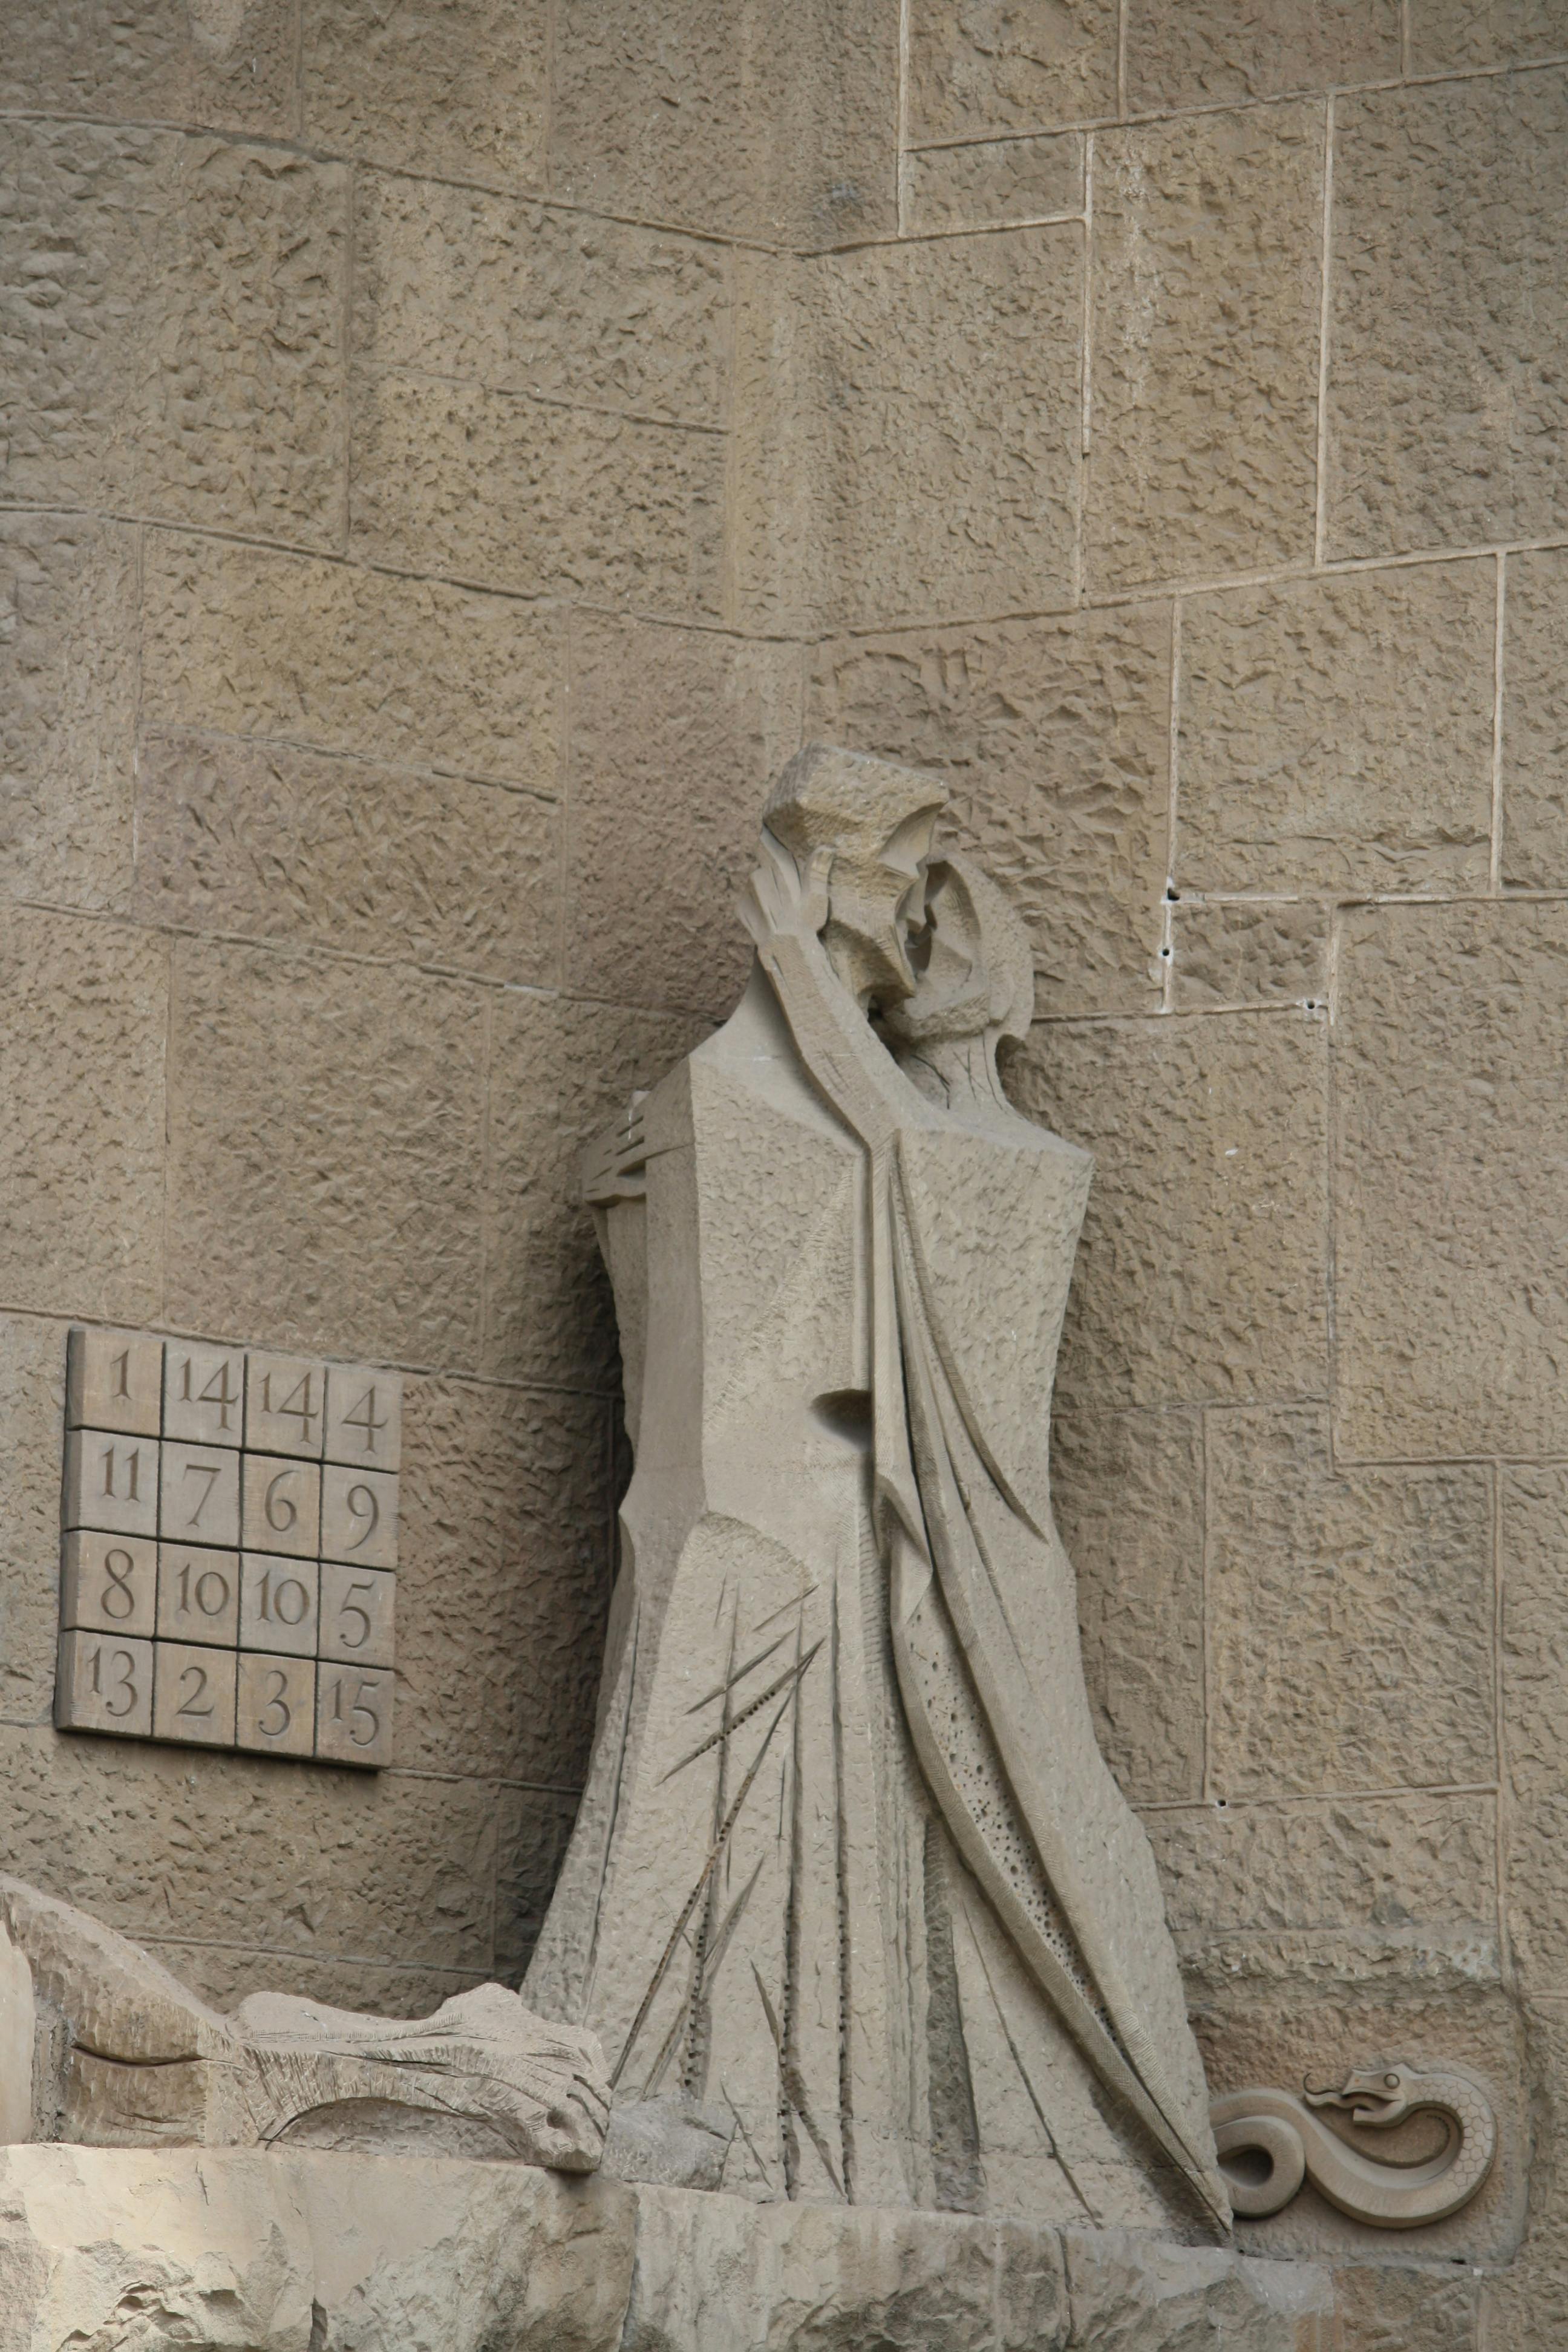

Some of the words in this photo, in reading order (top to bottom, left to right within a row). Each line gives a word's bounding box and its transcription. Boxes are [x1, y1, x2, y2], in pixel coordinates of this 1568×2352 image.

[111, 1349, 132, 1400] 1
[179, 1357, 238, 1431] 14
[258, 1371, 318, 1445] 14
[341, 1385, 388, 1454] 4
[102, 1446, 141, 1503] 11
[185, 1463, 221, 1528] 7
[264, 1470, 300, 1532] 6
[346, 1485, 379, 1551] 9
[100, 1549, 135, 1619] 8
[178, 1564, 230, 1616] 10
[254, 1570, 310, 1625] 10
[339, 1581, 375, 1648] 5
[88, 1647, 139, 1717] 13
[175, 1666, 214, 1718] 2
[258, 1670, 291, 1736] 3
[332, 1679, 381, 1746] 15
